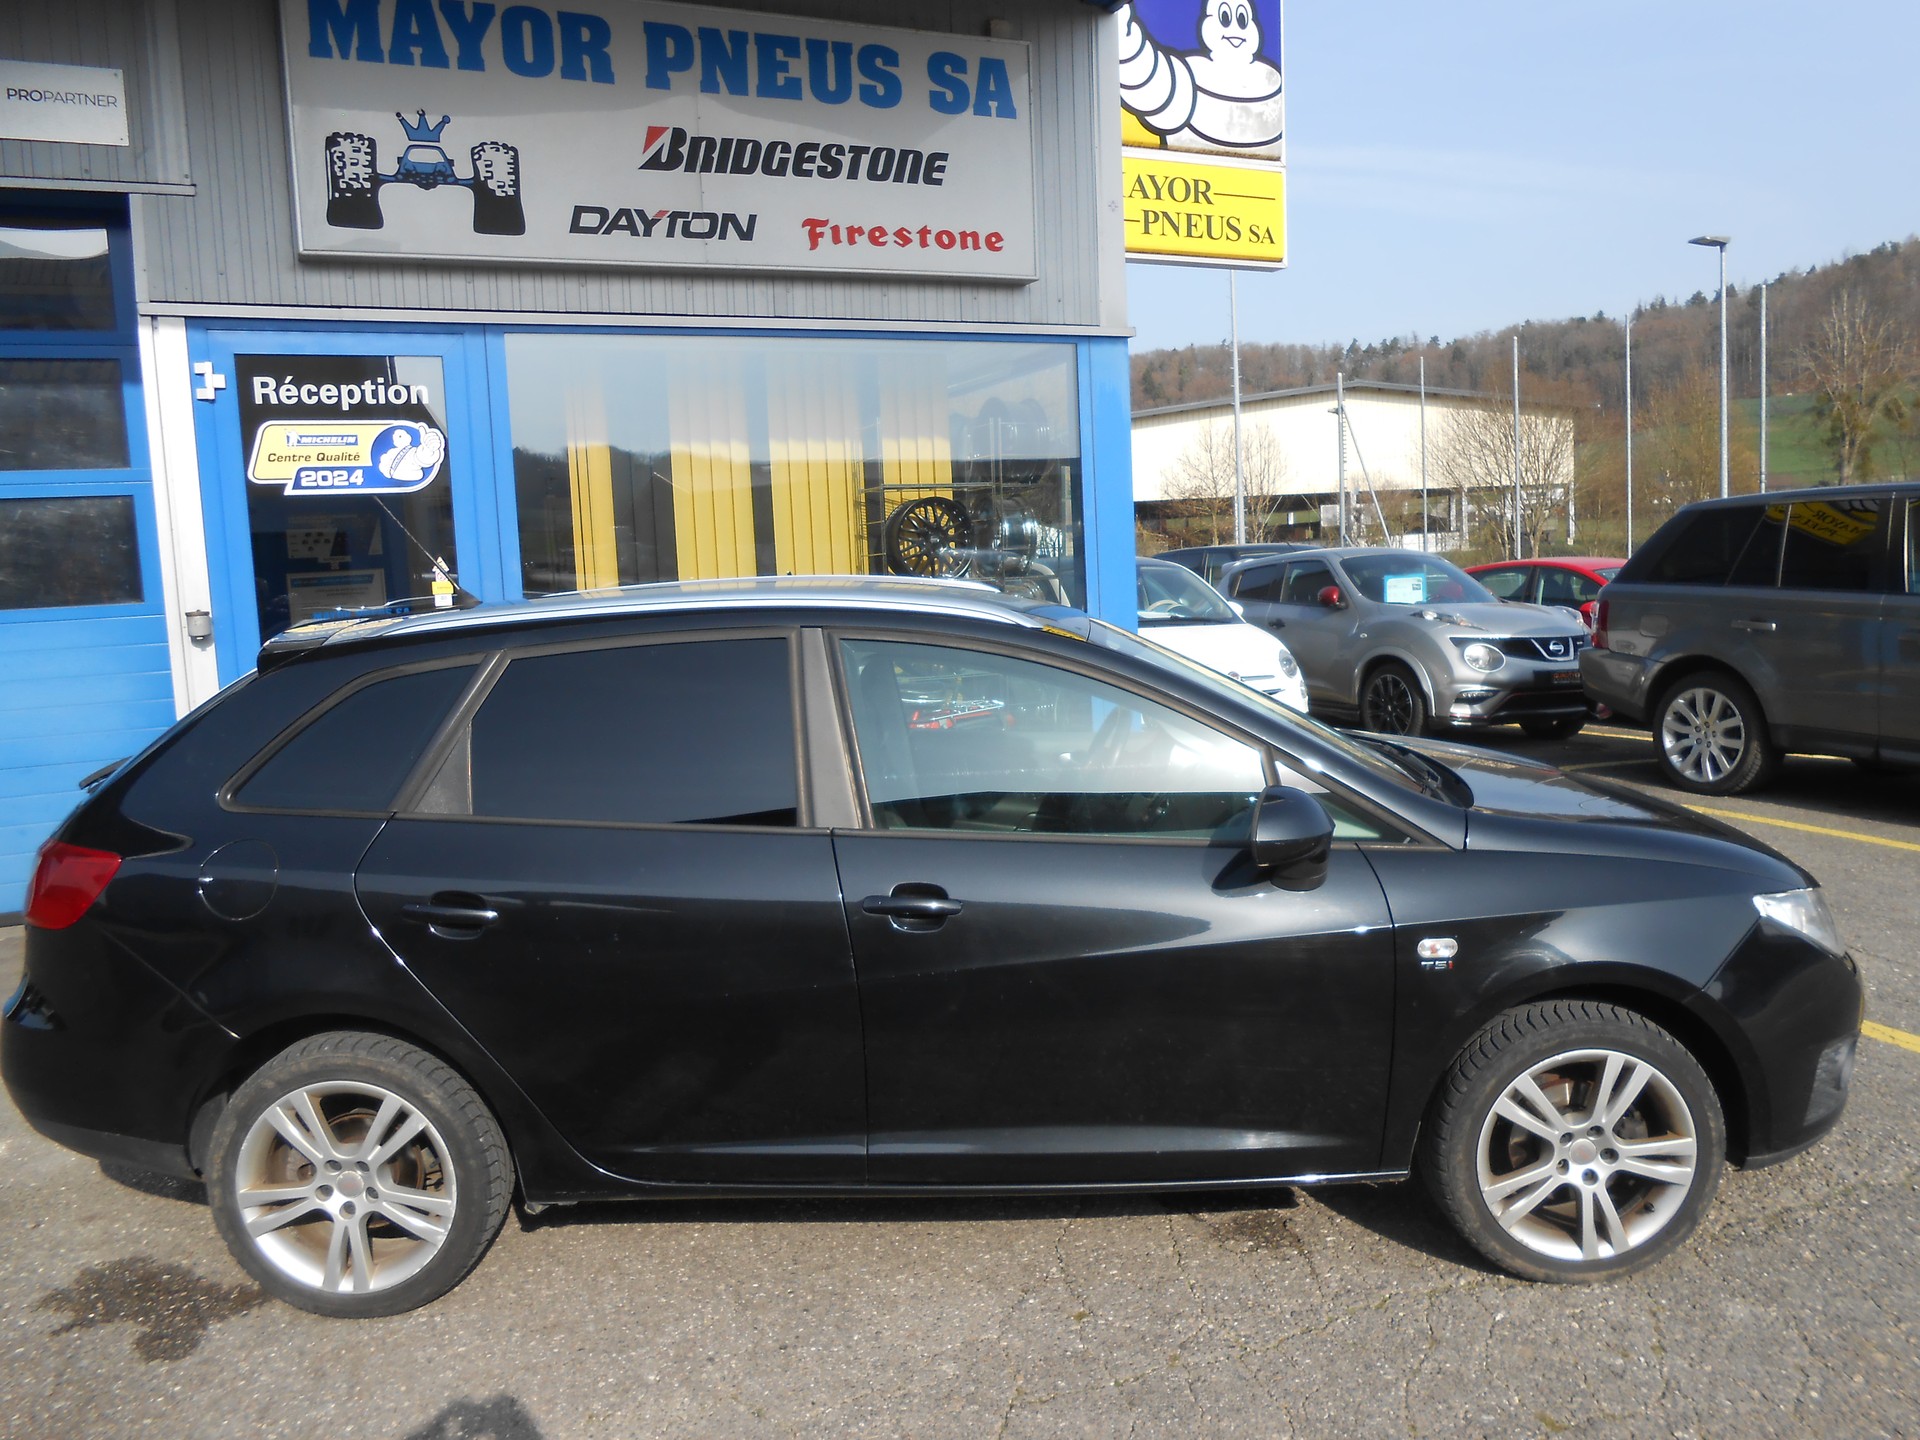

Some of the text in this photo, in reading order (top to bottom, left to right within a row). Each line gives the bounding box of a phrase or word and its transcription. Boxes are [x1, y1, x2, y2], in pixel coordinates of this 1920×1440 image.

[308, 0, 1017, 119] MAYOR PNEUS SA
[6, 87, 118, 108] PROPARTNER
[638, 125, 949, 187] BRIDGESTONE
[1122, 172, 1214, 205] AYOR
[569, 205, 757, 241] DAYTON
[802, 217, 1004, 252] Firestone
[1141, 209, 1276, 245] PNEUS SA
[253, 376, 429, 411] Réception
[300, 435, 357, 444] MICHELIN
[267, 452, 360, 463] Centre Qualité
[300, 469, 364, 487] 2024
